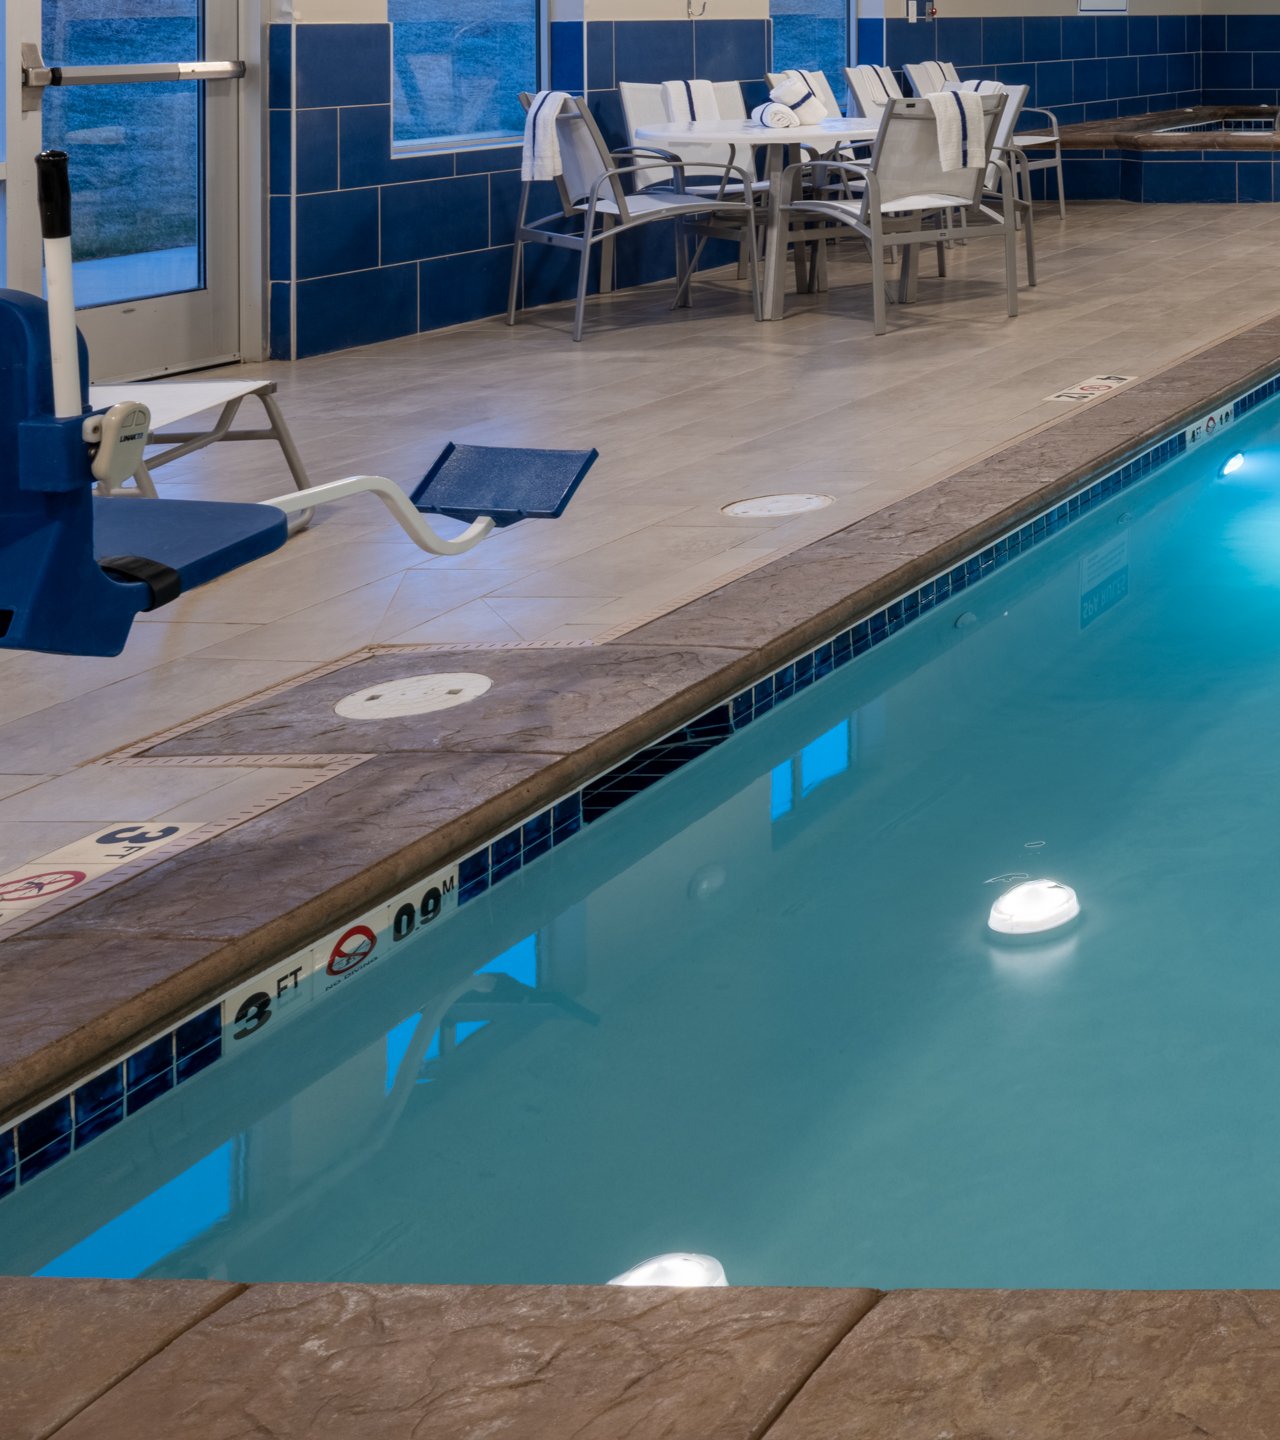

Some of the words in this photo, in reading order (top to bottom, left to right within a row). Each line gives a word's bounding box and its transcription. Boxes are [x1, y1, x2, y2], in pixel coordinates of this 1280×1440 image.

[96, 826, 180, 844] 3
[104, 846, 146, 859] FT
[233, 991, 272, 1040] 3
[277, 966, 302, 999] FT
